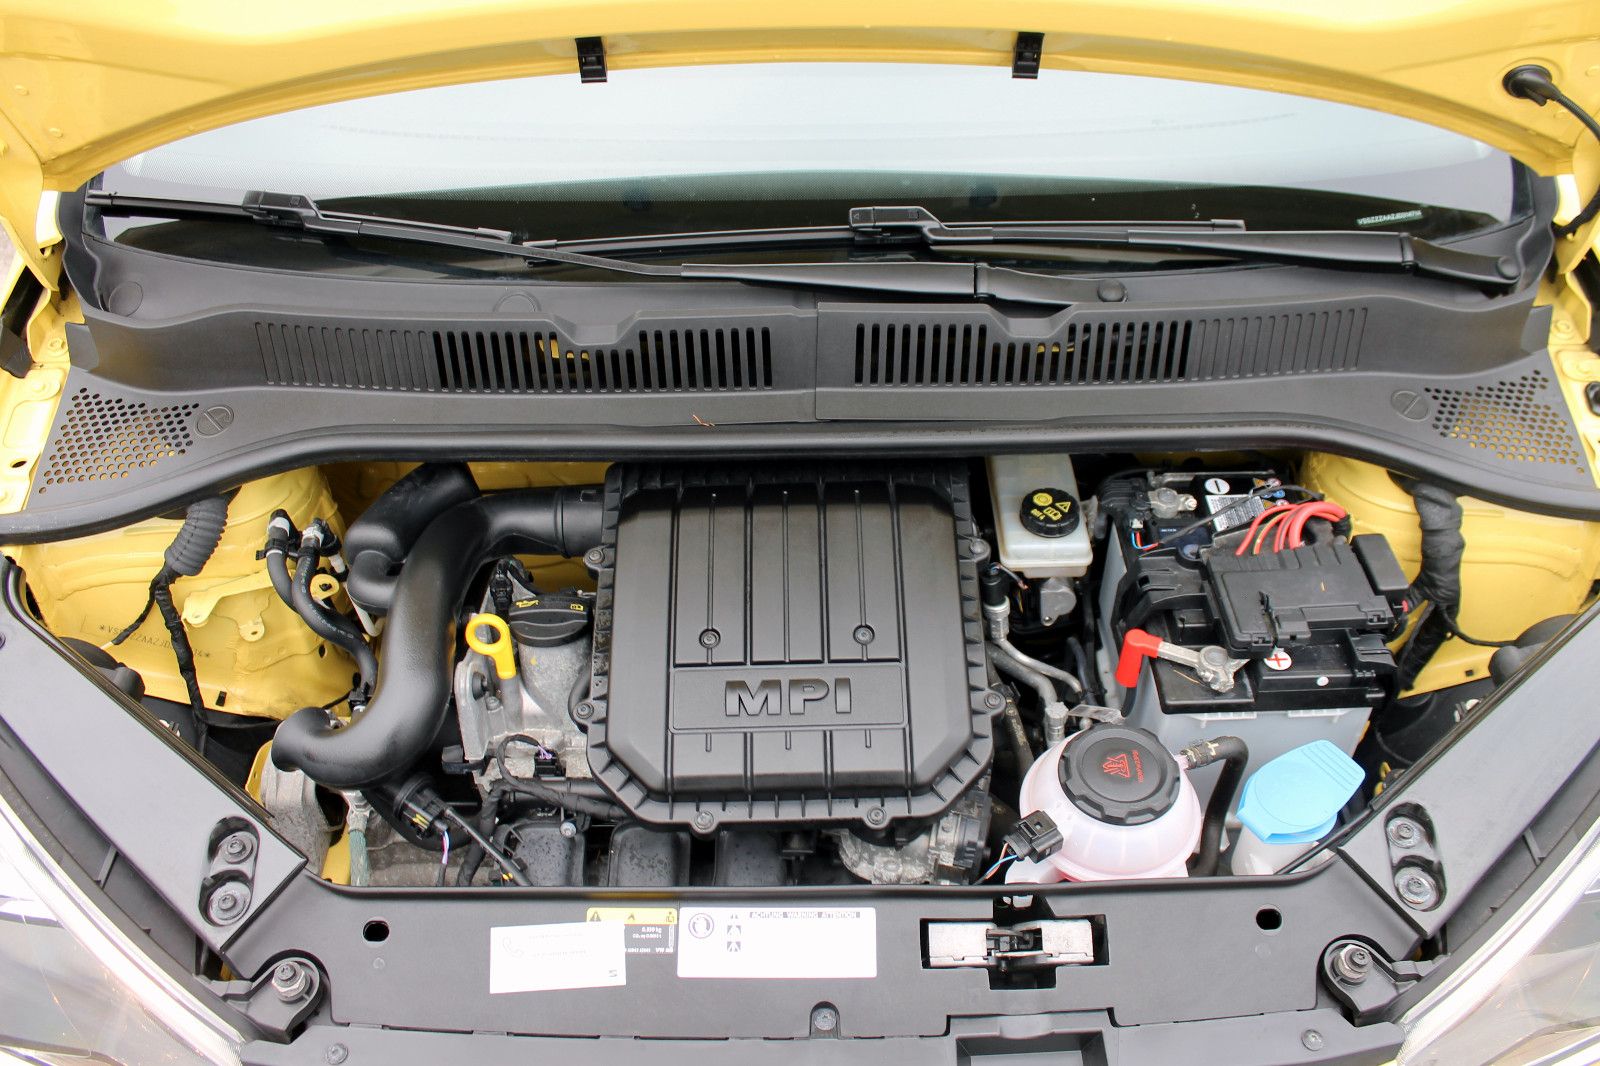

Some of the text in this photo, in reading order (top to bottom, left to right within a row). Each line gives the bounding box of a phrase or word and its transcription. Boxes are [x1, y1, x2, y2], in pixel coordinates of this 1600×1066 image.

[725, 677, 852, 717] MPI
[751, 911, 857, 919] ACHTUNG WARNING ATTENTION
